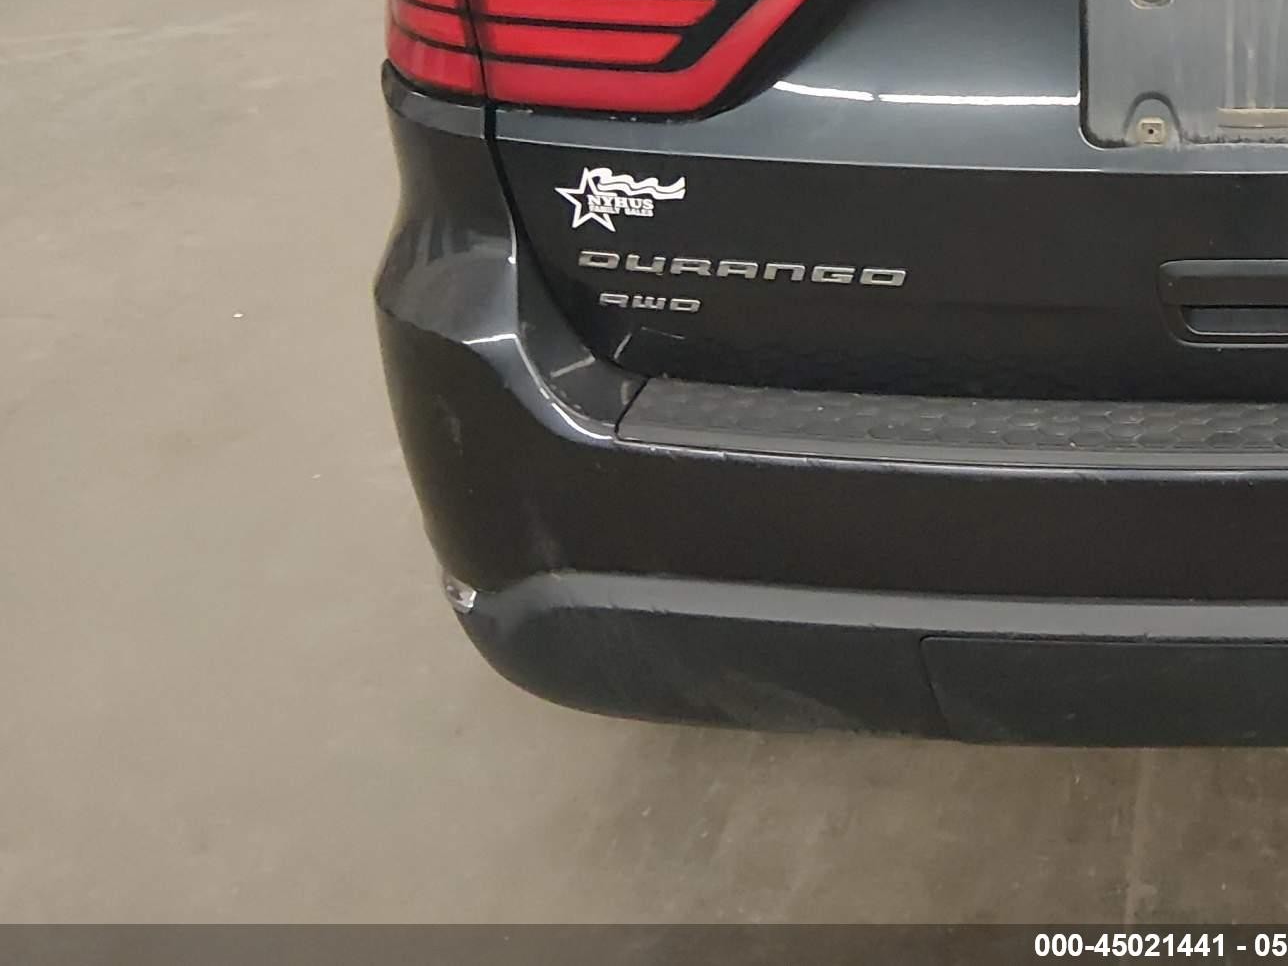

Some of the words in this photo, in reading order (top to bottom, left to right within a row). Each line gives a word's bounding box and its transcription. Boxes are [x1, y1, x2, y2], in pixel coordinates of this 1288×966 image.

[587, 194, 655, 210] NYHUS
[578, 250, 907, 286] DURANGO
[599, 292, 701, 313] AWD
